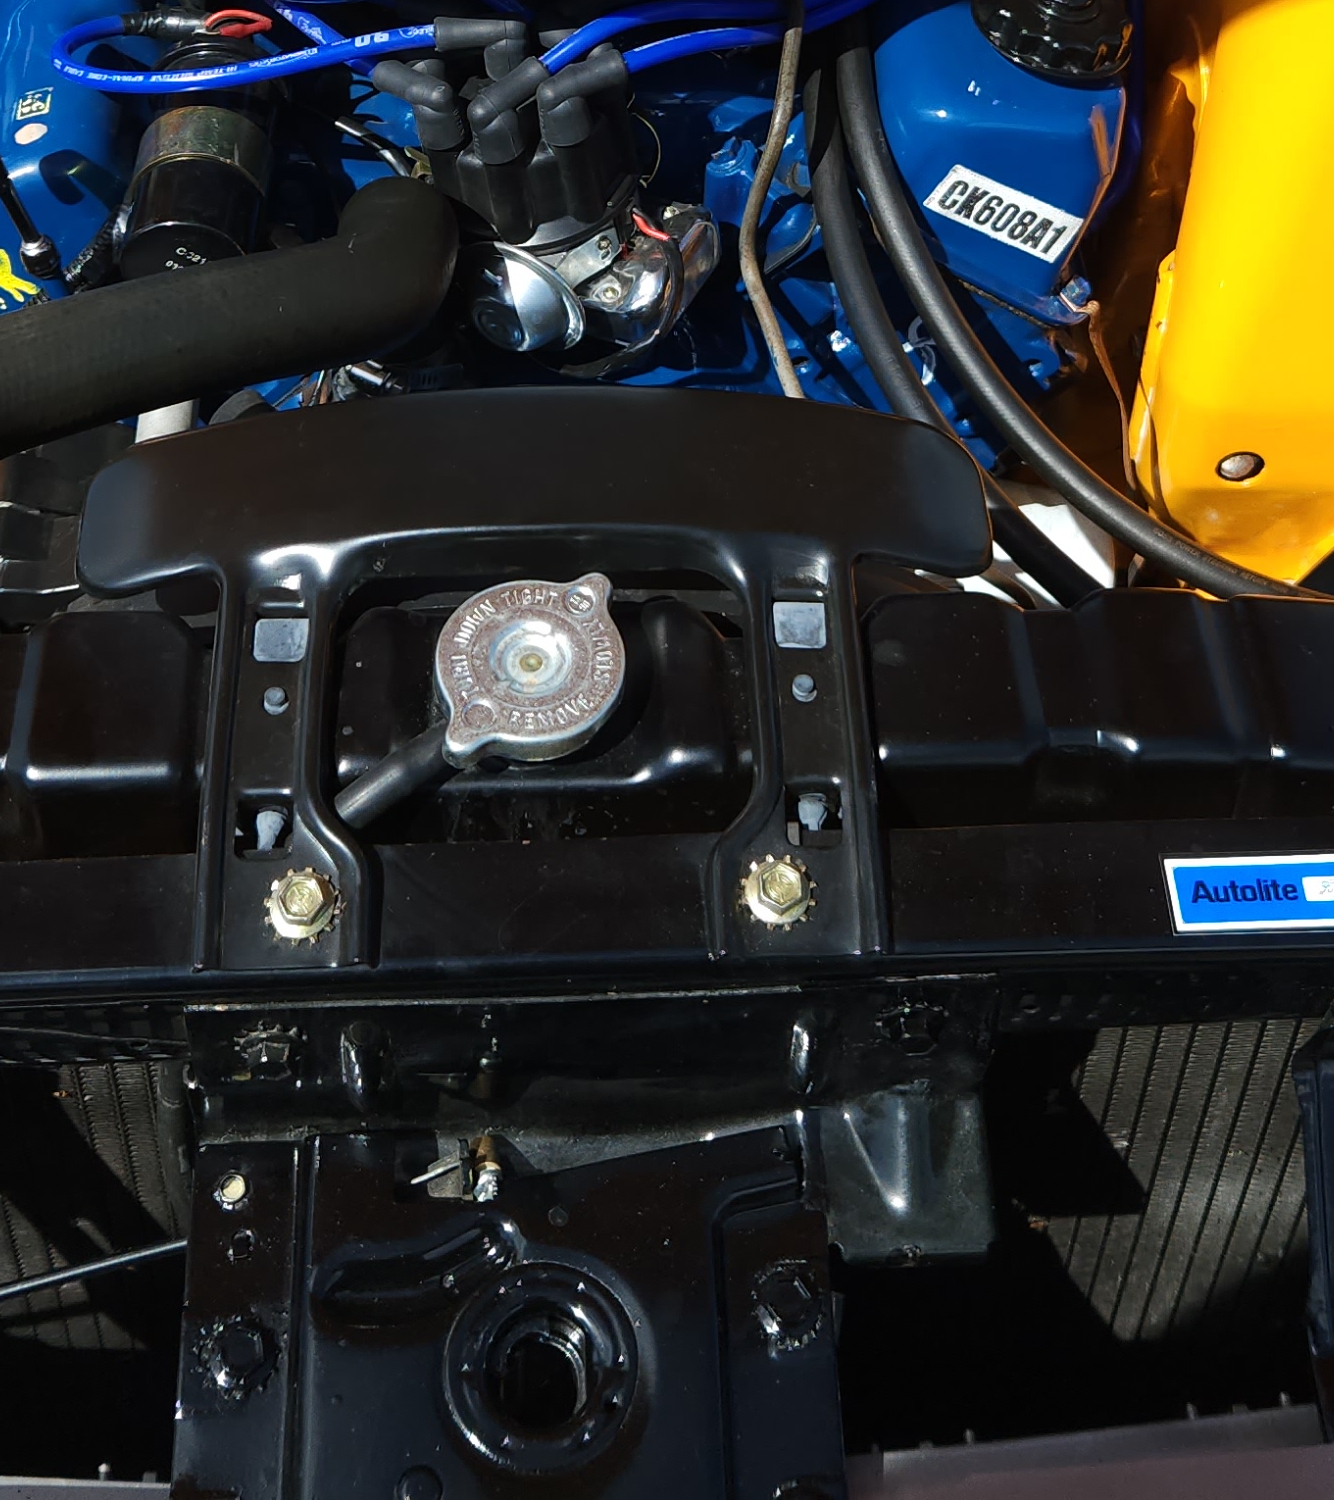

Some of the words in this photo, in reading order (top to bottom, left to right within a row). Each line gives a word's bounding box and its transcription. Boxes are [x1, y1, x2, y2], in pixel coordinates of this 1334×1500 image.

[937, 180, 1068, 255] CK608A1
[453, 599, 497, 650] DOWN
[501, 588, 559, 607] TIGHT
[508, 692, 596, 731] REMOVE
[1191, 878, 1299, 905] Autolite
